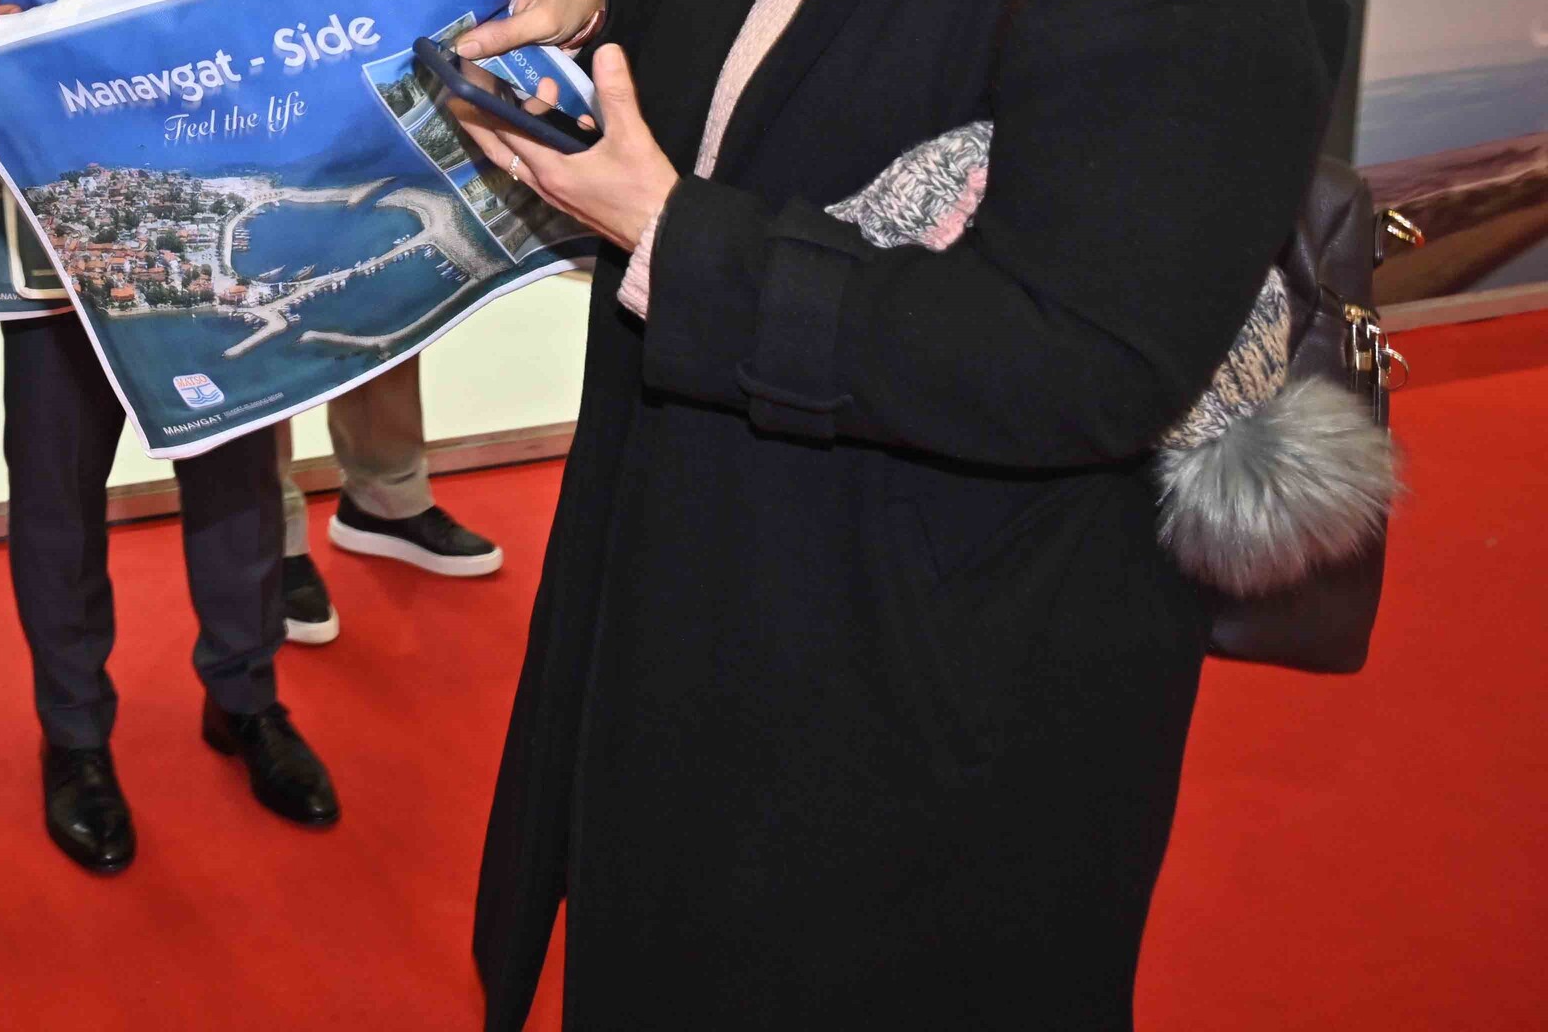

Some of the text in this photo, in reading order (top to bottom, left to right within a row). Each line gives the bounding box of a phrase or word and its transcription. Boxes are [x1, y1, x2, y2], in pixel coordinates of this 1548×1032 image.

[58, 49, 242, 113] Manavgat
[273, 14, 382, 68] Side
[164, 91, 308, 141] Feel the life
[175, 374, 208, 388] MATSO
[163, 413, 222, 436] MANAVGAT
